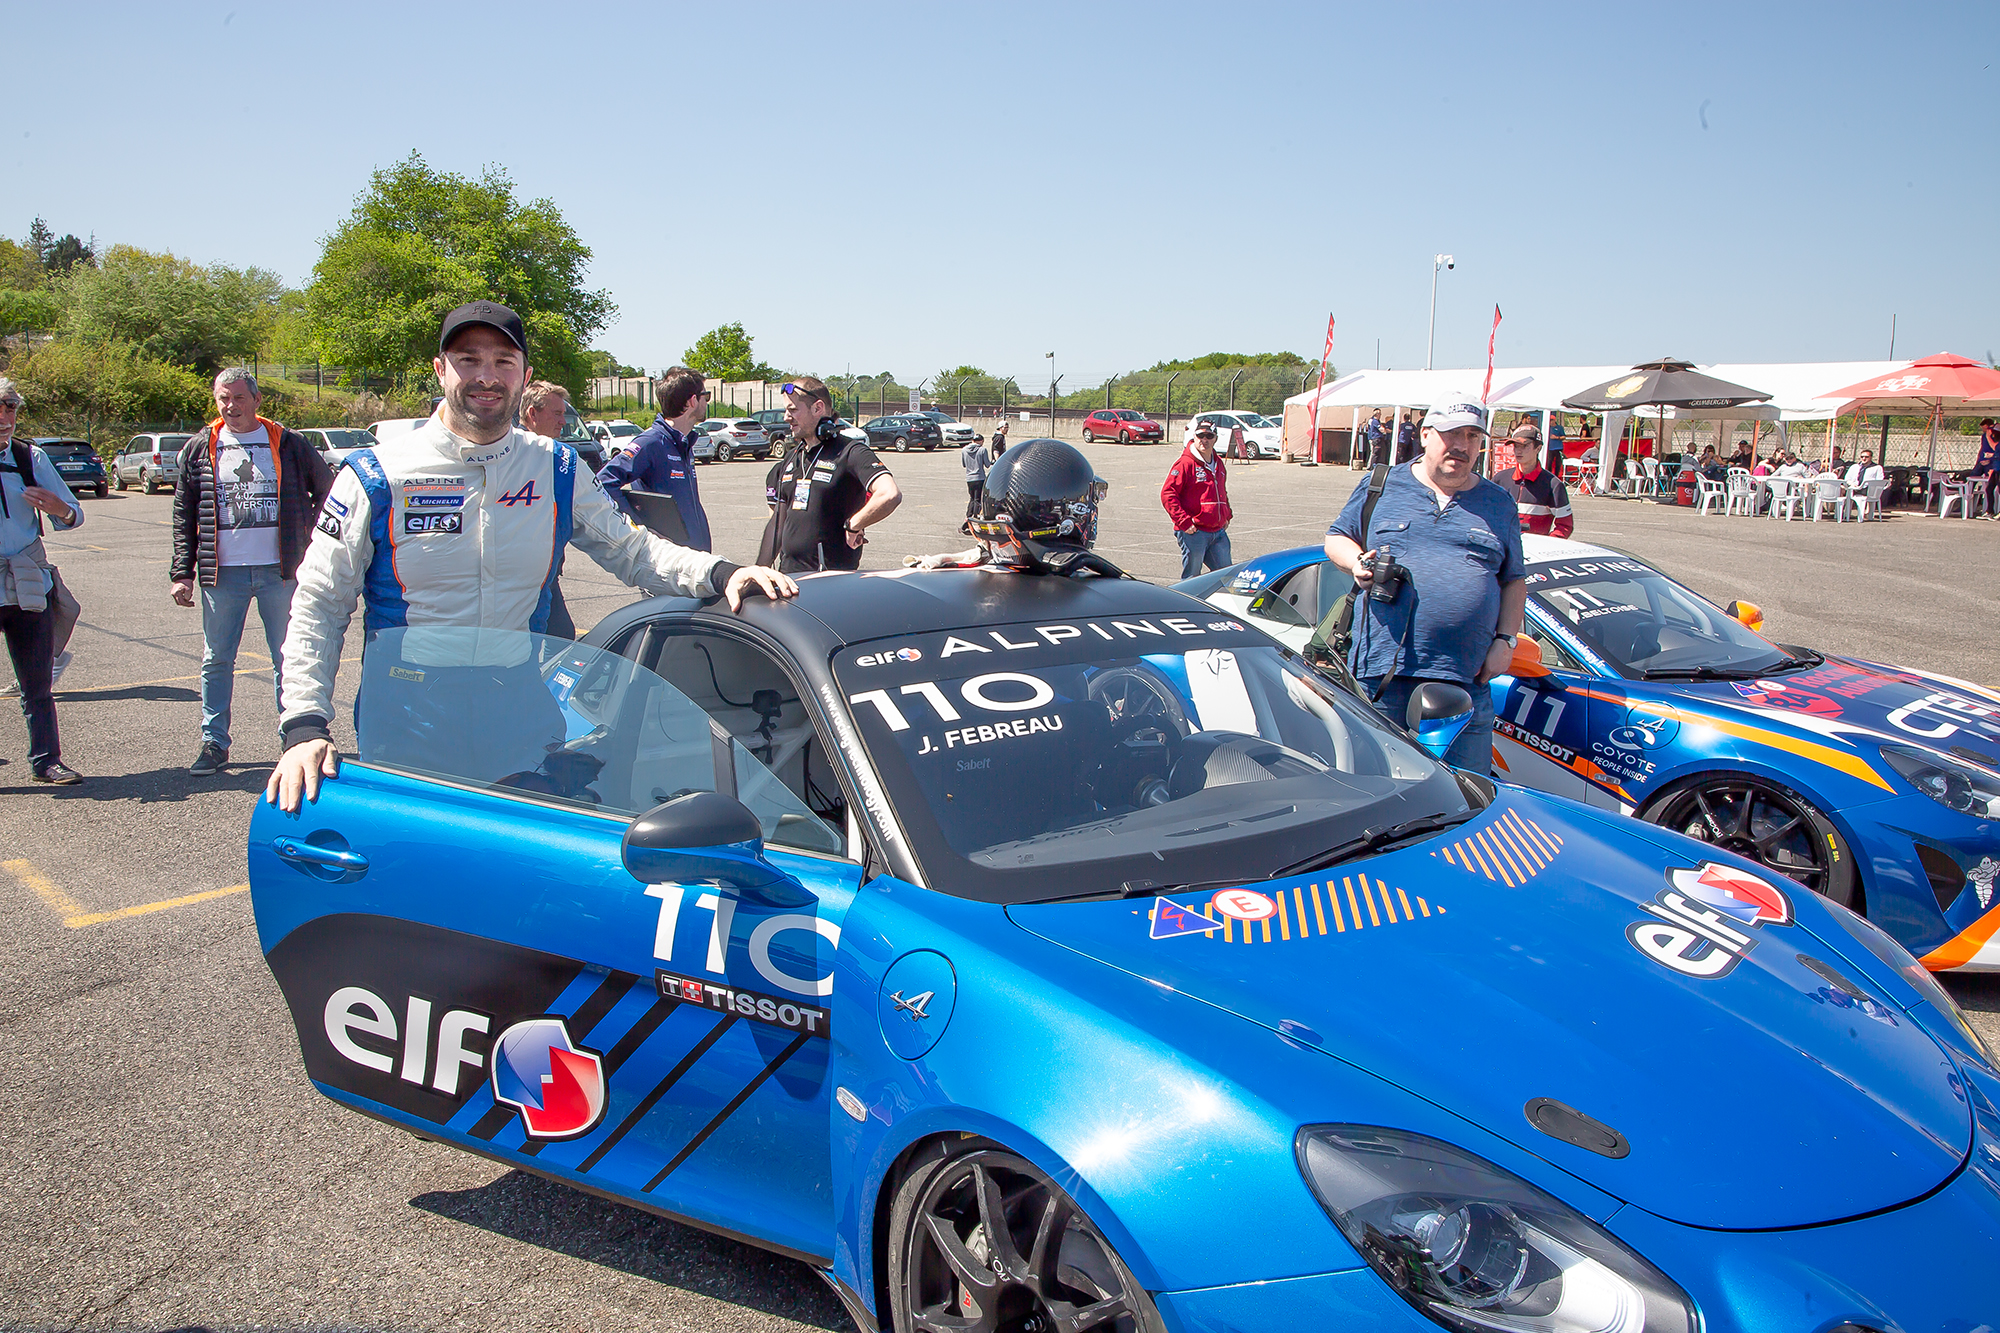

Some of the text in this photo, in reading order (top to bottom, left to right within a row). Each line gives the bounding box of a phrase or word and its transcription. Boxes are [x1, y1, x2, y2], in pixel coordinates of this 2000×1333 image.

[466, 446, 511, 463] ALPINE
[236, 500, 278, 510] VERSION
[407, 515, 441, 530] elf
[1548, 561, 1642, 580] ALPINE
[1550, 587, 1605, 610] 11
[940, 617, 1207, 659] ALPINE
[1207, 622, 1229, 632] elf
[855, 650, 898, 668] elf
[392, 666, 423, 682] Sabelt
[849, 671, 1055, 732] 110
[1514, 685, 1567, 738] 11
[917, 714, 1064, 755] J. FEBREAU
[1515, 726, 1575, 762] TISSOT
[956, 756, 992, 772] Sabelt
[1592, 742, 1657, 774] COYOTE
[1592, 755, 1622, 774] PEOPLE
[1621, 767, 1648, 784] INSIDE
[1228, 896, 1261, 913] E
[643, 880, 842, 997] 110
[1633, 892, 1753, 976] elf
[704, 985, 824, 1032] TISSOT
[323, 986, 491, 1095] elf
